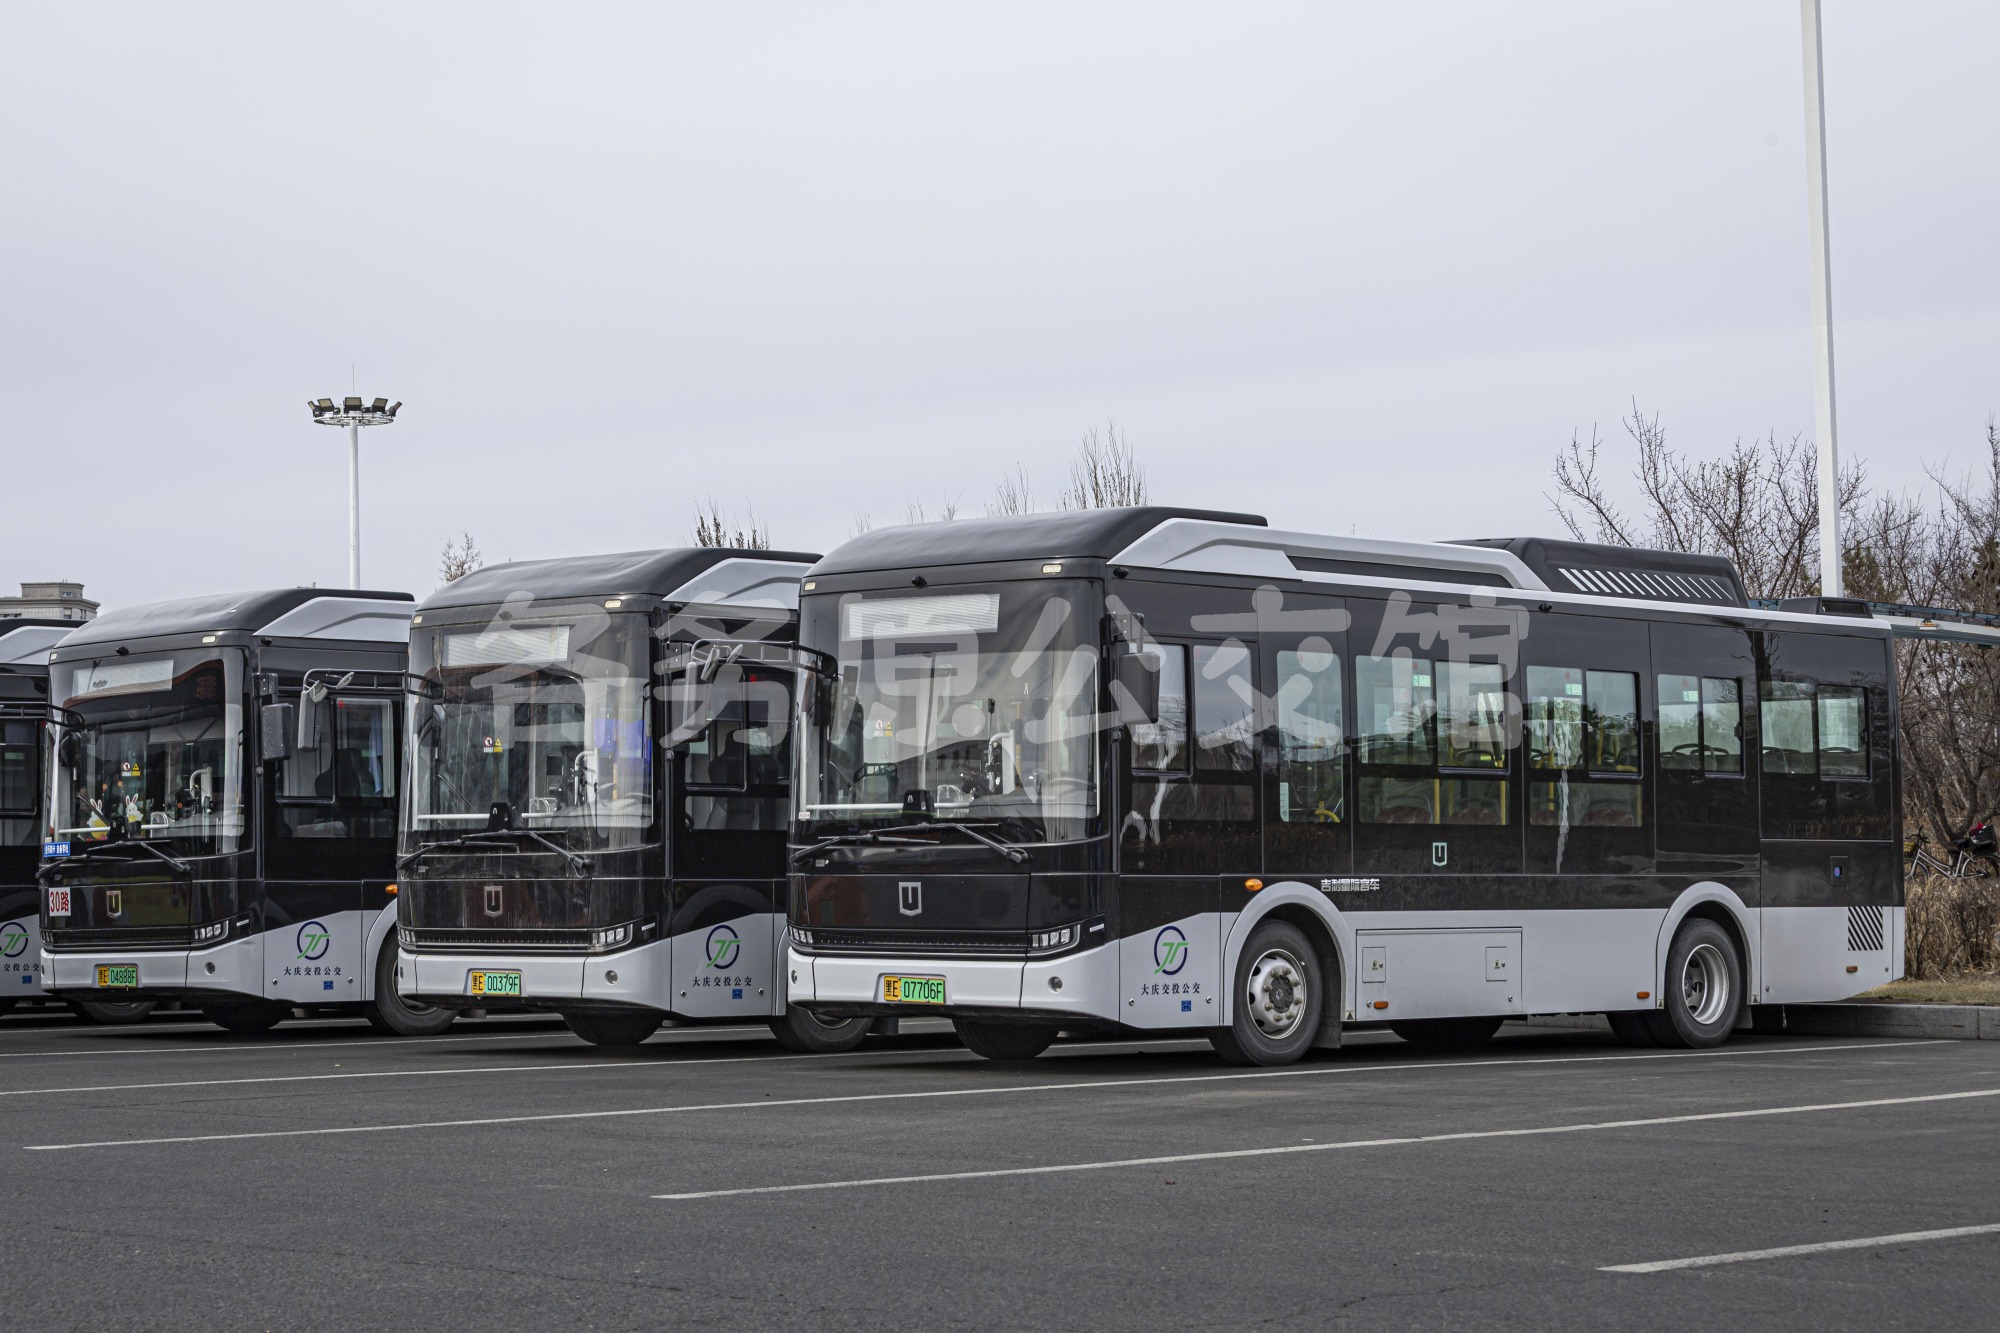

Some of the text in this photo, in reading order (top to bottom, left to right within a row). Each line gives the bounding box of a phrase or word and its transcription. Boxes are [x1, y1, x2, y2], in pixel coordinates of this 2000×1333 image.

[50, 891, 69, 912] 30路
[0, 963, 40, 972] 交投公交
[283, 966, 342, 976] 大庆交投公交
[692, 976, 752, 987] 大庆交投公交
[1141, 982, 1201, 996] 大庆交投公交
